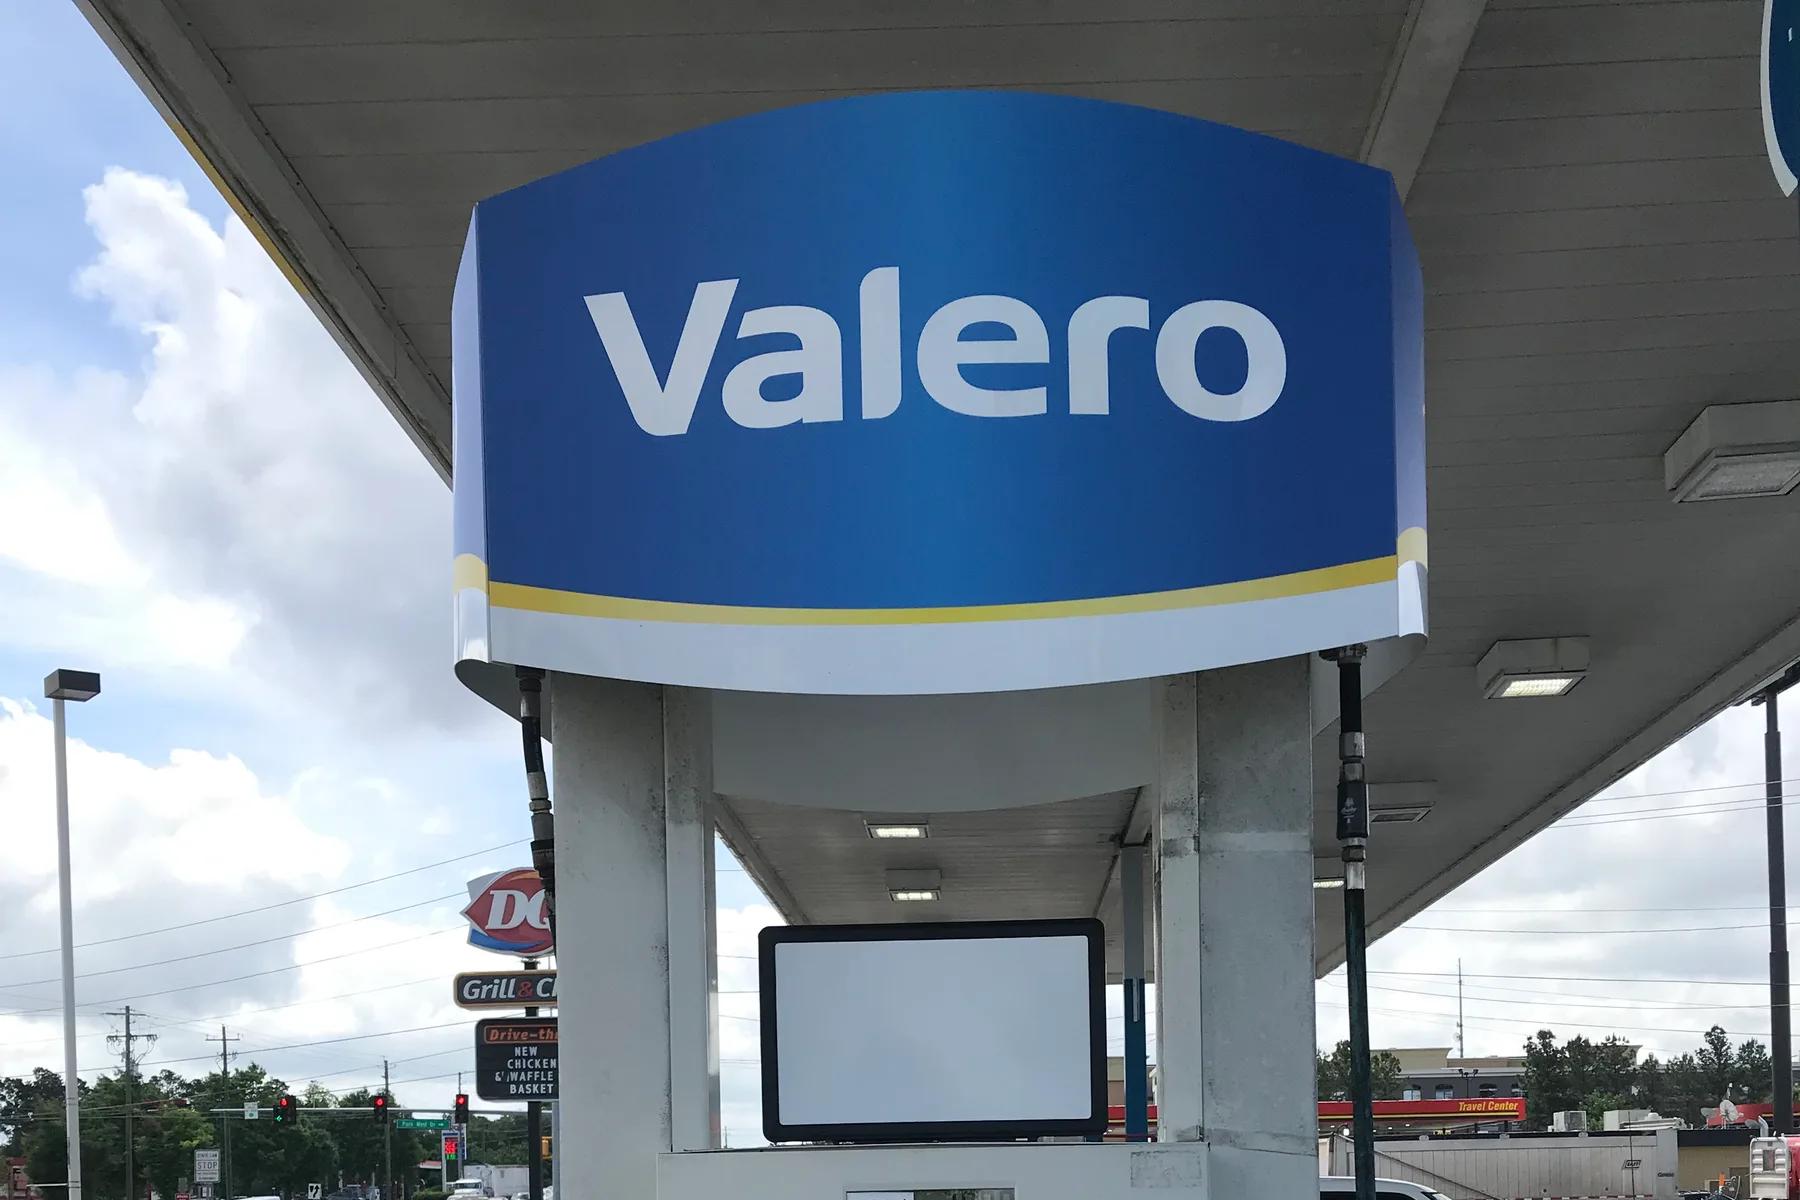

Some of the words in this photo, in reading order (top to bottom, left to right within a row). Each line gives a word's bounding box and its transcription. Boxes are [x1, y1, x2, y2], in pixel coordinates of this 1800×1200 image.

[582, 266, 1287, 437] Valero
[463, 978, 516, 999] Grill
[518, 981, 533, 998] &
[514, 1046, 538, 1057] NEW
[507, 1058, 557, 1069] CHICKEN
[510, 1071, 554, 1082] WAFFLE
[509, 1083, 554, 1094] BASKET
[1459, 1101, 1486, 1111] Travel
[1488, 1101, 1518, 1111] Center
[197, 1161, 218, 1169] STOP
